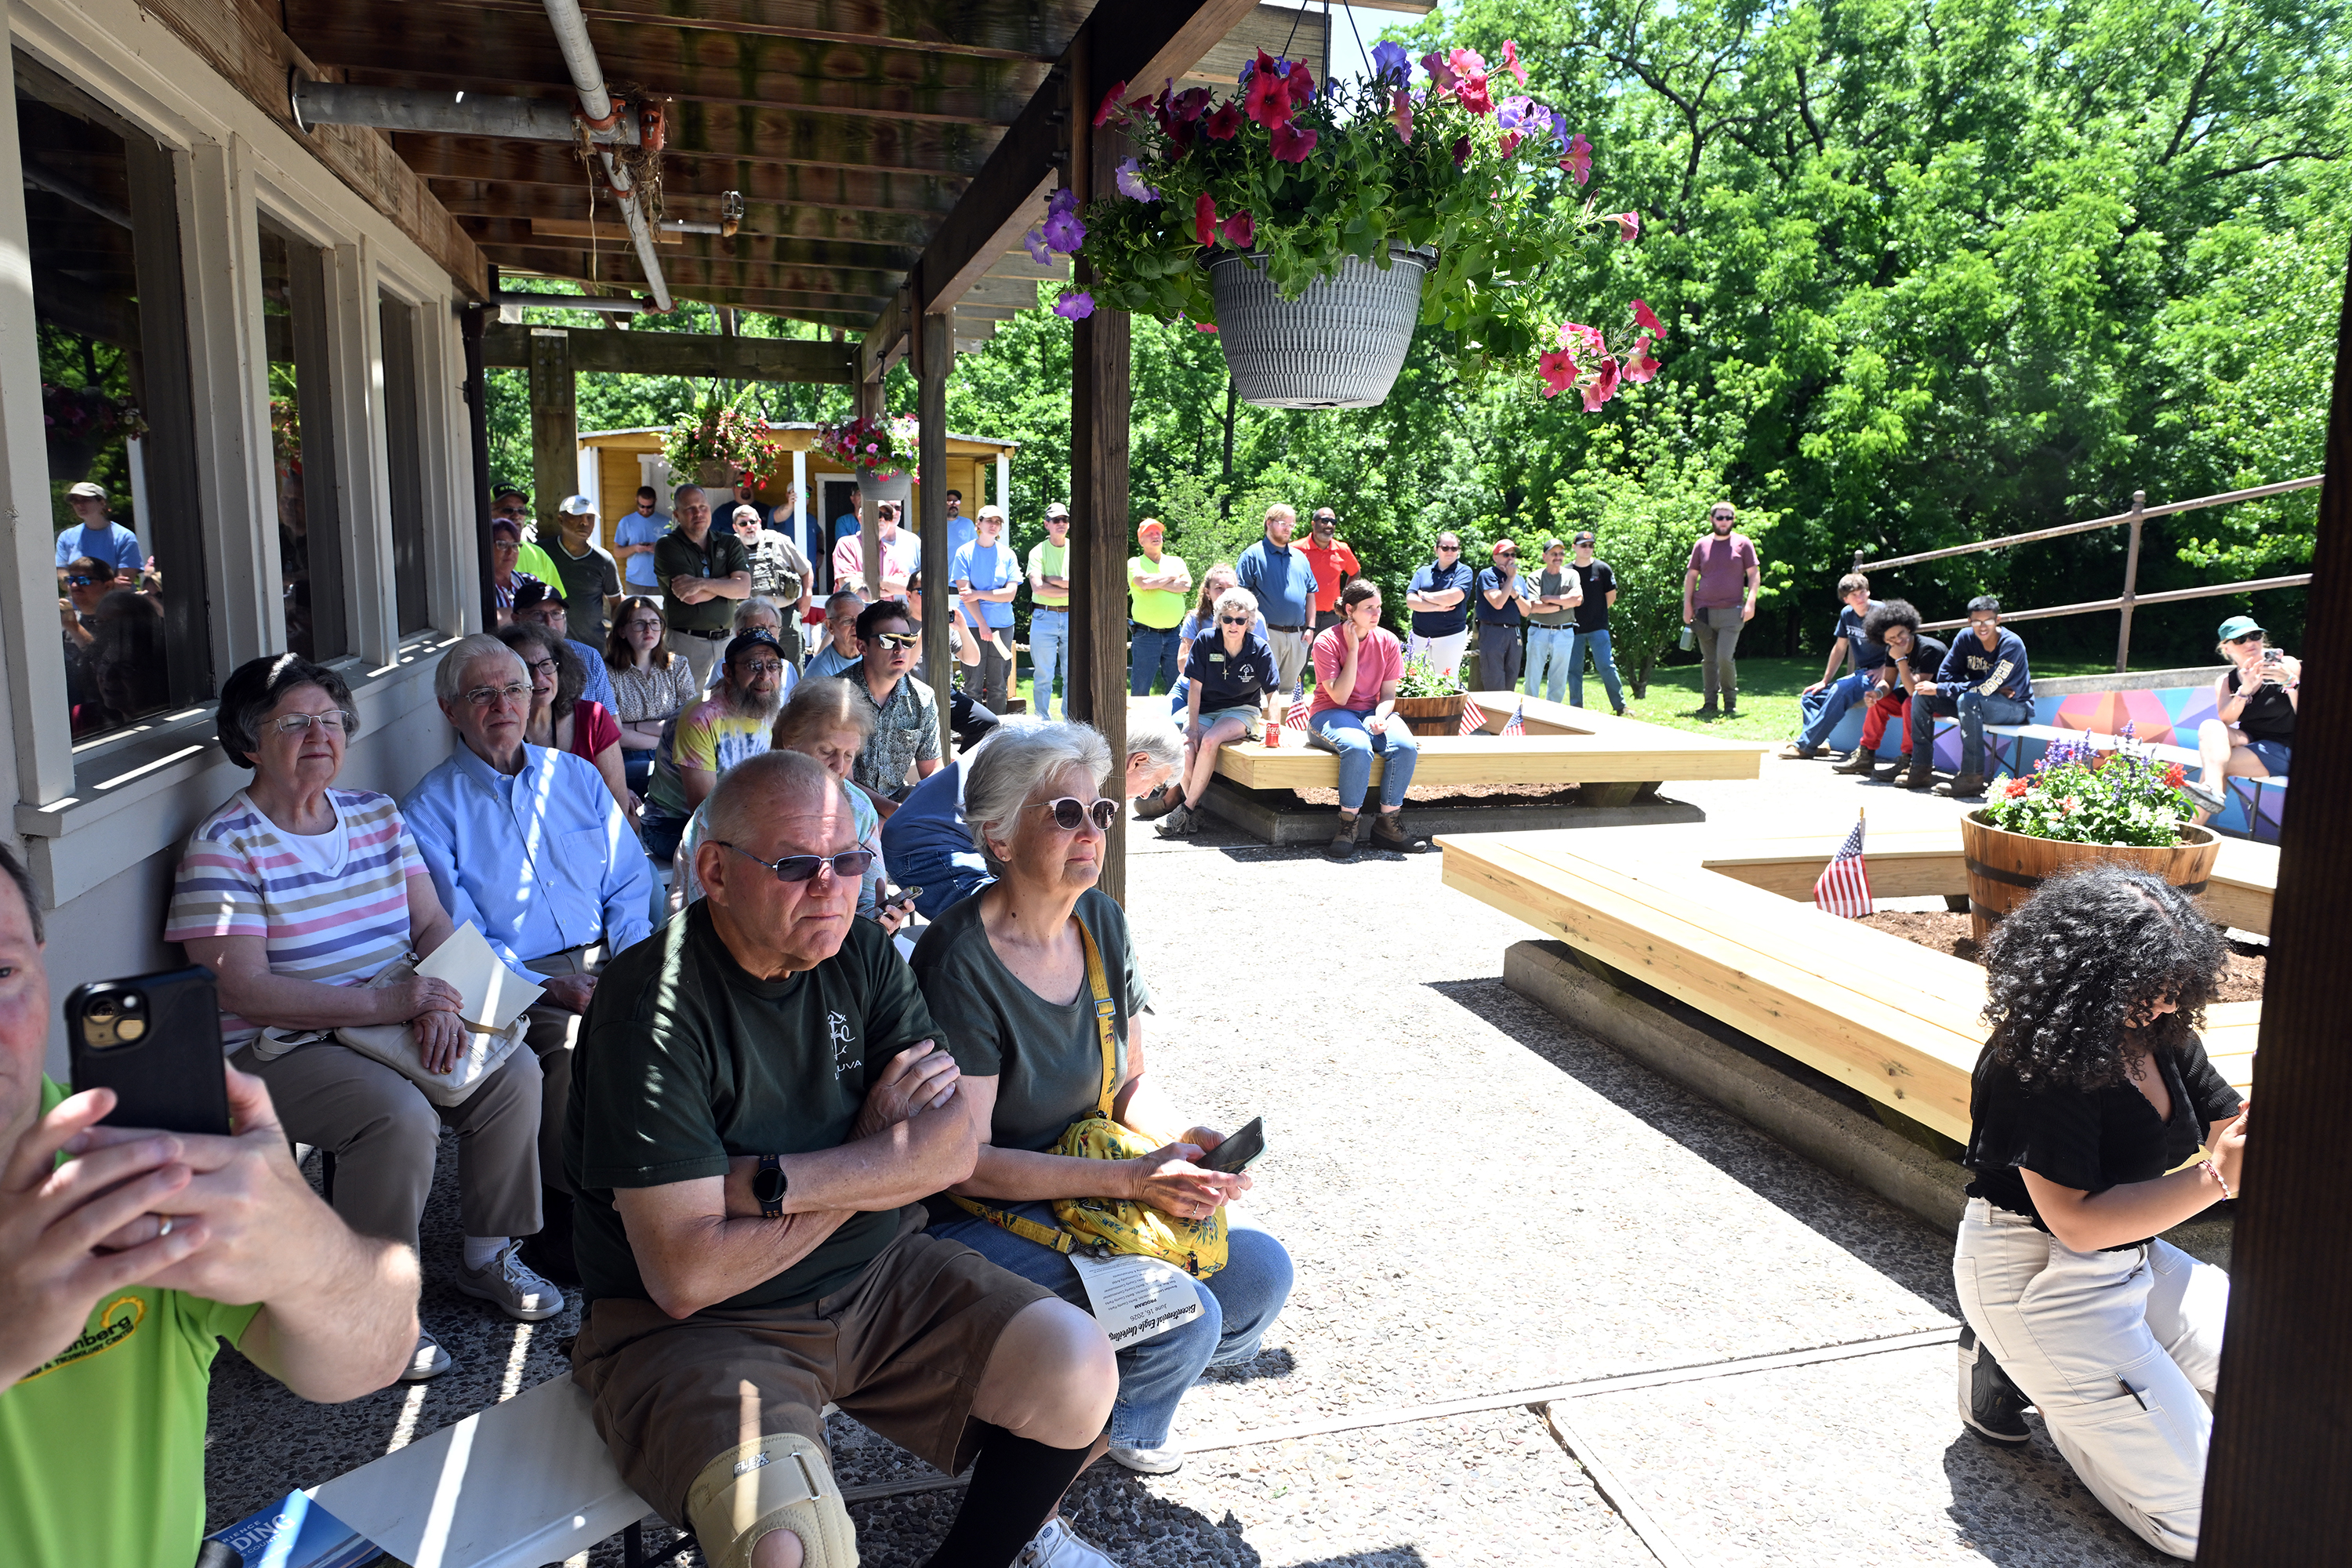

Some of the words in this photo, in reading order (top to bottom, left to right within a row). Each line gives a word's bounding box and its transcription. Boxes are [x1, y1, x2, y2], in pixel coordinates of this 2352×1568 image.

[1104, 1283, 1125, 1292] Commissioner
[1102, 1290, 1124, 1299] Commissioner
[1134, 1298, 1156, 1308] PROGRAM
[1154, 1303, 1166, 1312] June
[1129, 1311, 1144, 1321] 2026
[1156, 1303, 1196, 1326] Bicentennial
[1138, 1319, 1154, 1332] Eagle
[54, 1341, 103, 1365] TECHNOLOGY
[104, 1324, 135, 1345] CENTER
[733, 1451, 767, 1473] FLEX
[222, 1519, 262, 1544] RIENCE
[231, 1512, 296, 1552] DING
